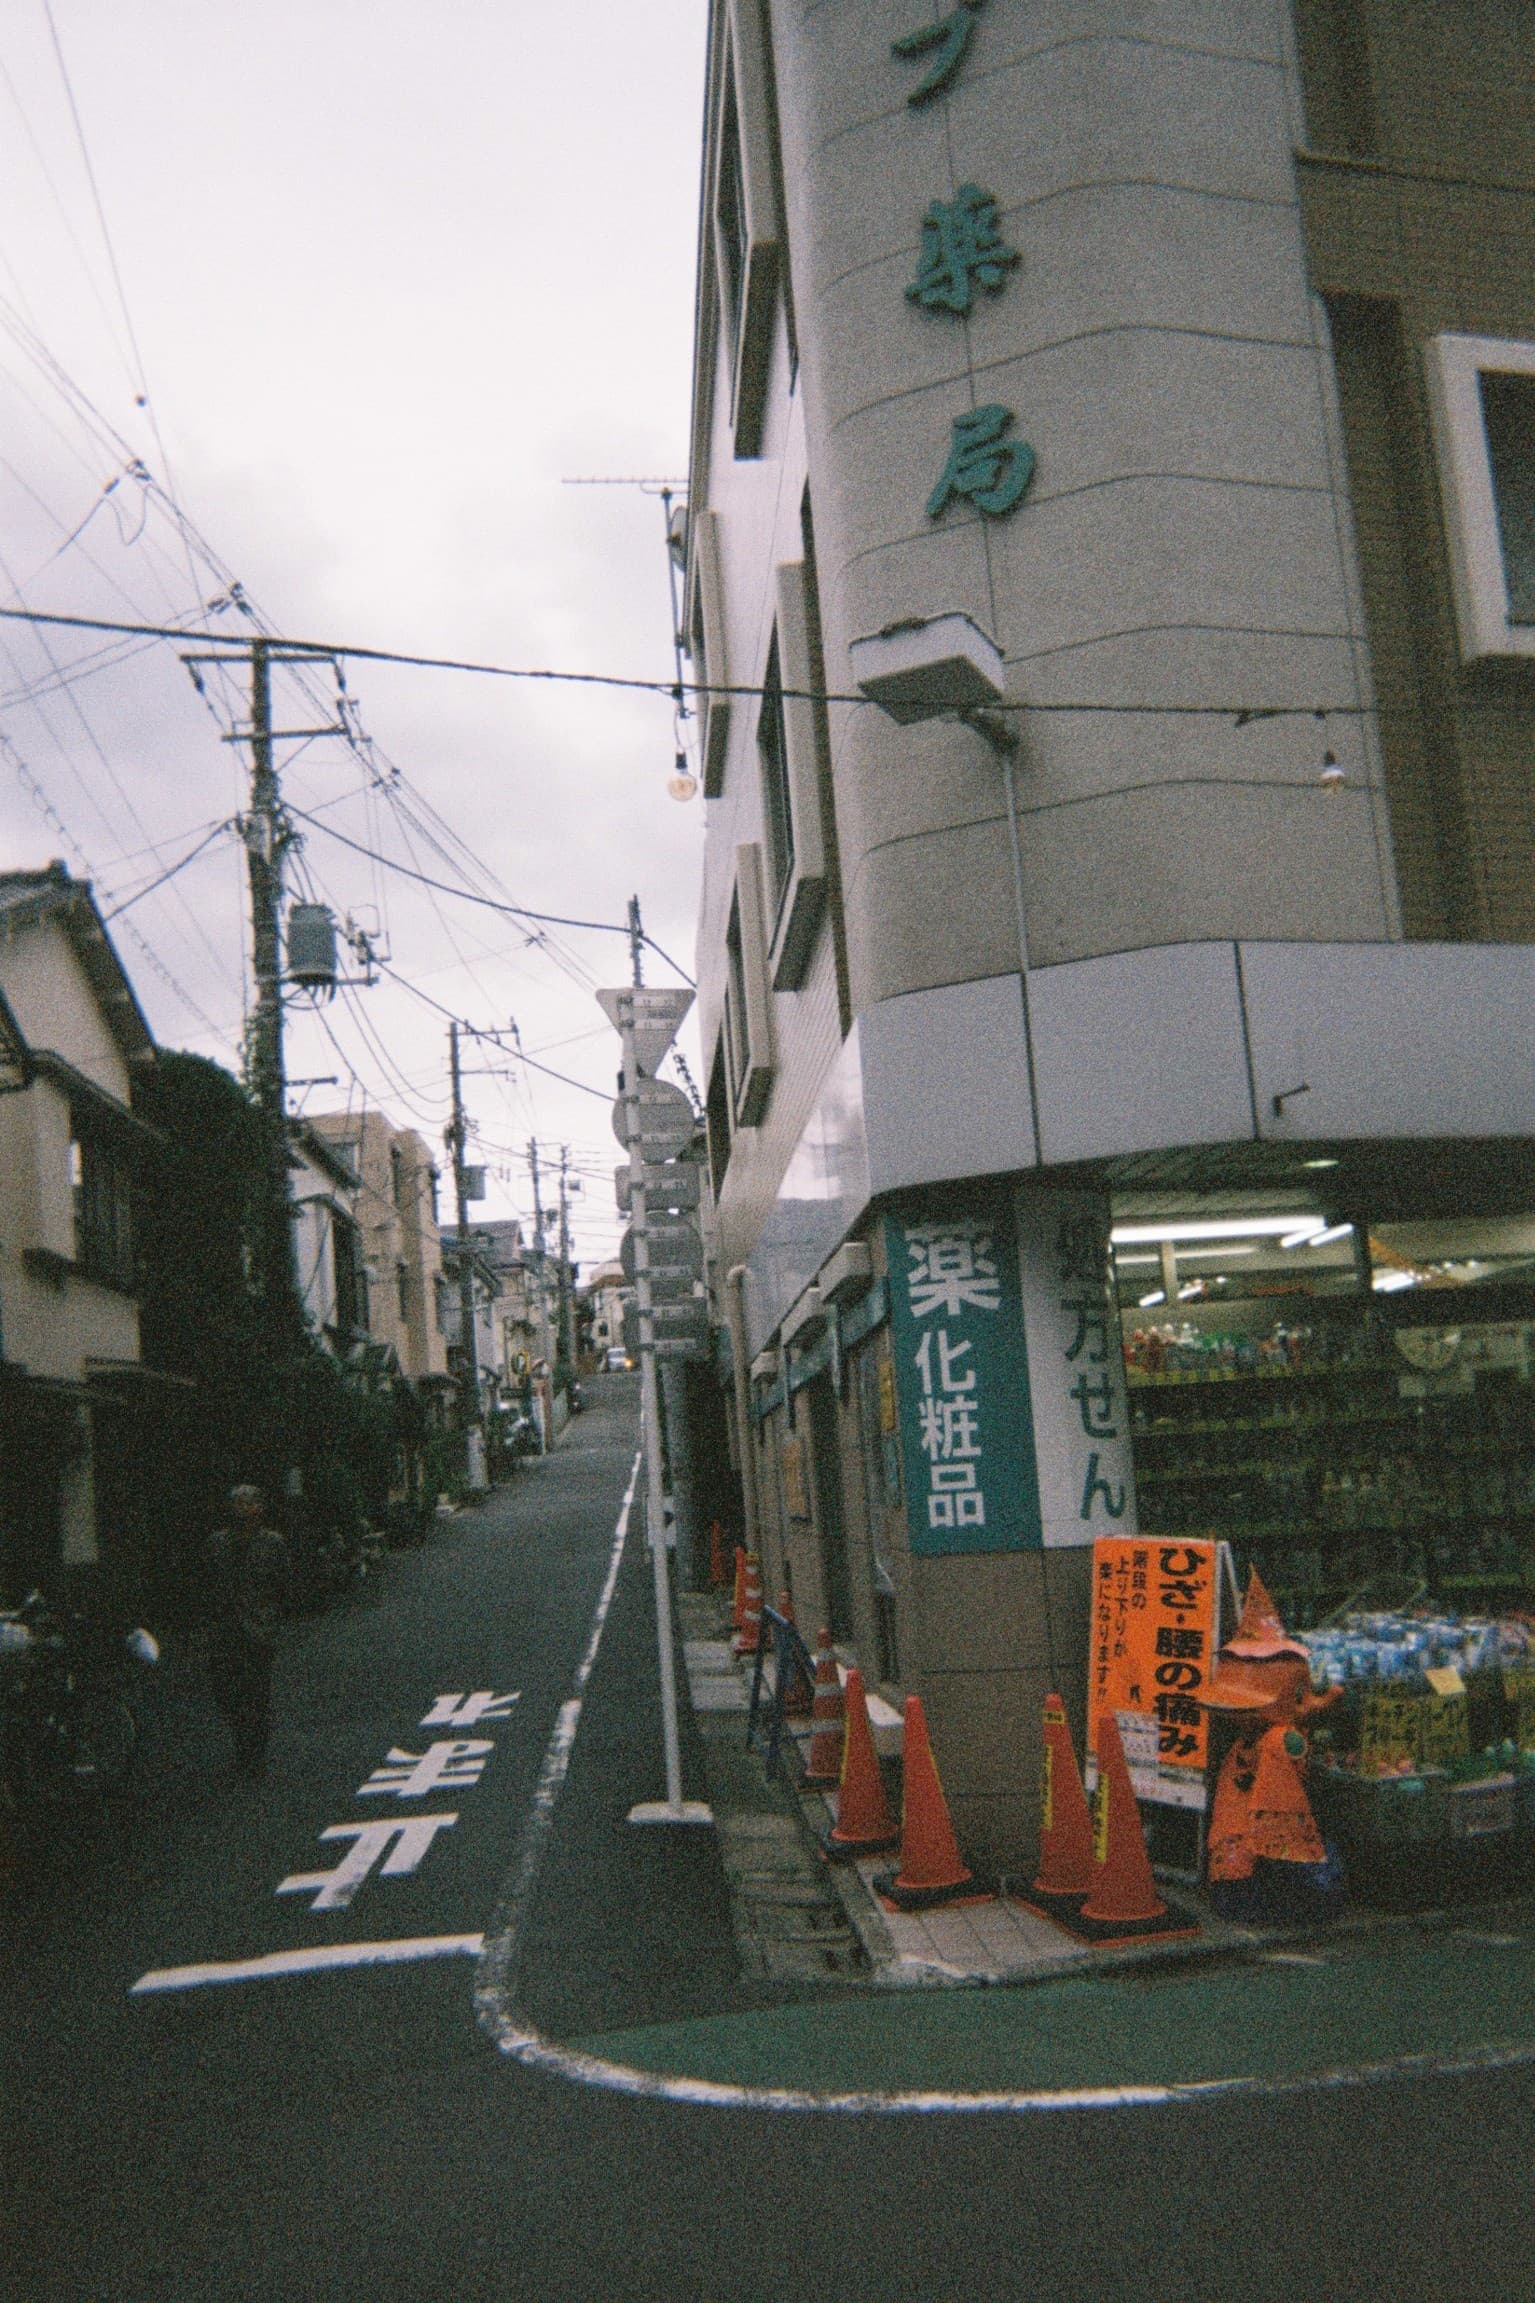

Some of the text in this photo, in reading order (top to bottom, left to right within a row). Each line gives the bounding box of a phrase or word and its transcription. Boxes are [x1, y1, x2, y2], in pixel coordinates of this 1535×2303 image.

[903, 1220, 1003, 1529] 薬 化粧品
[275, 1690, 522, 1913] 止まれ
